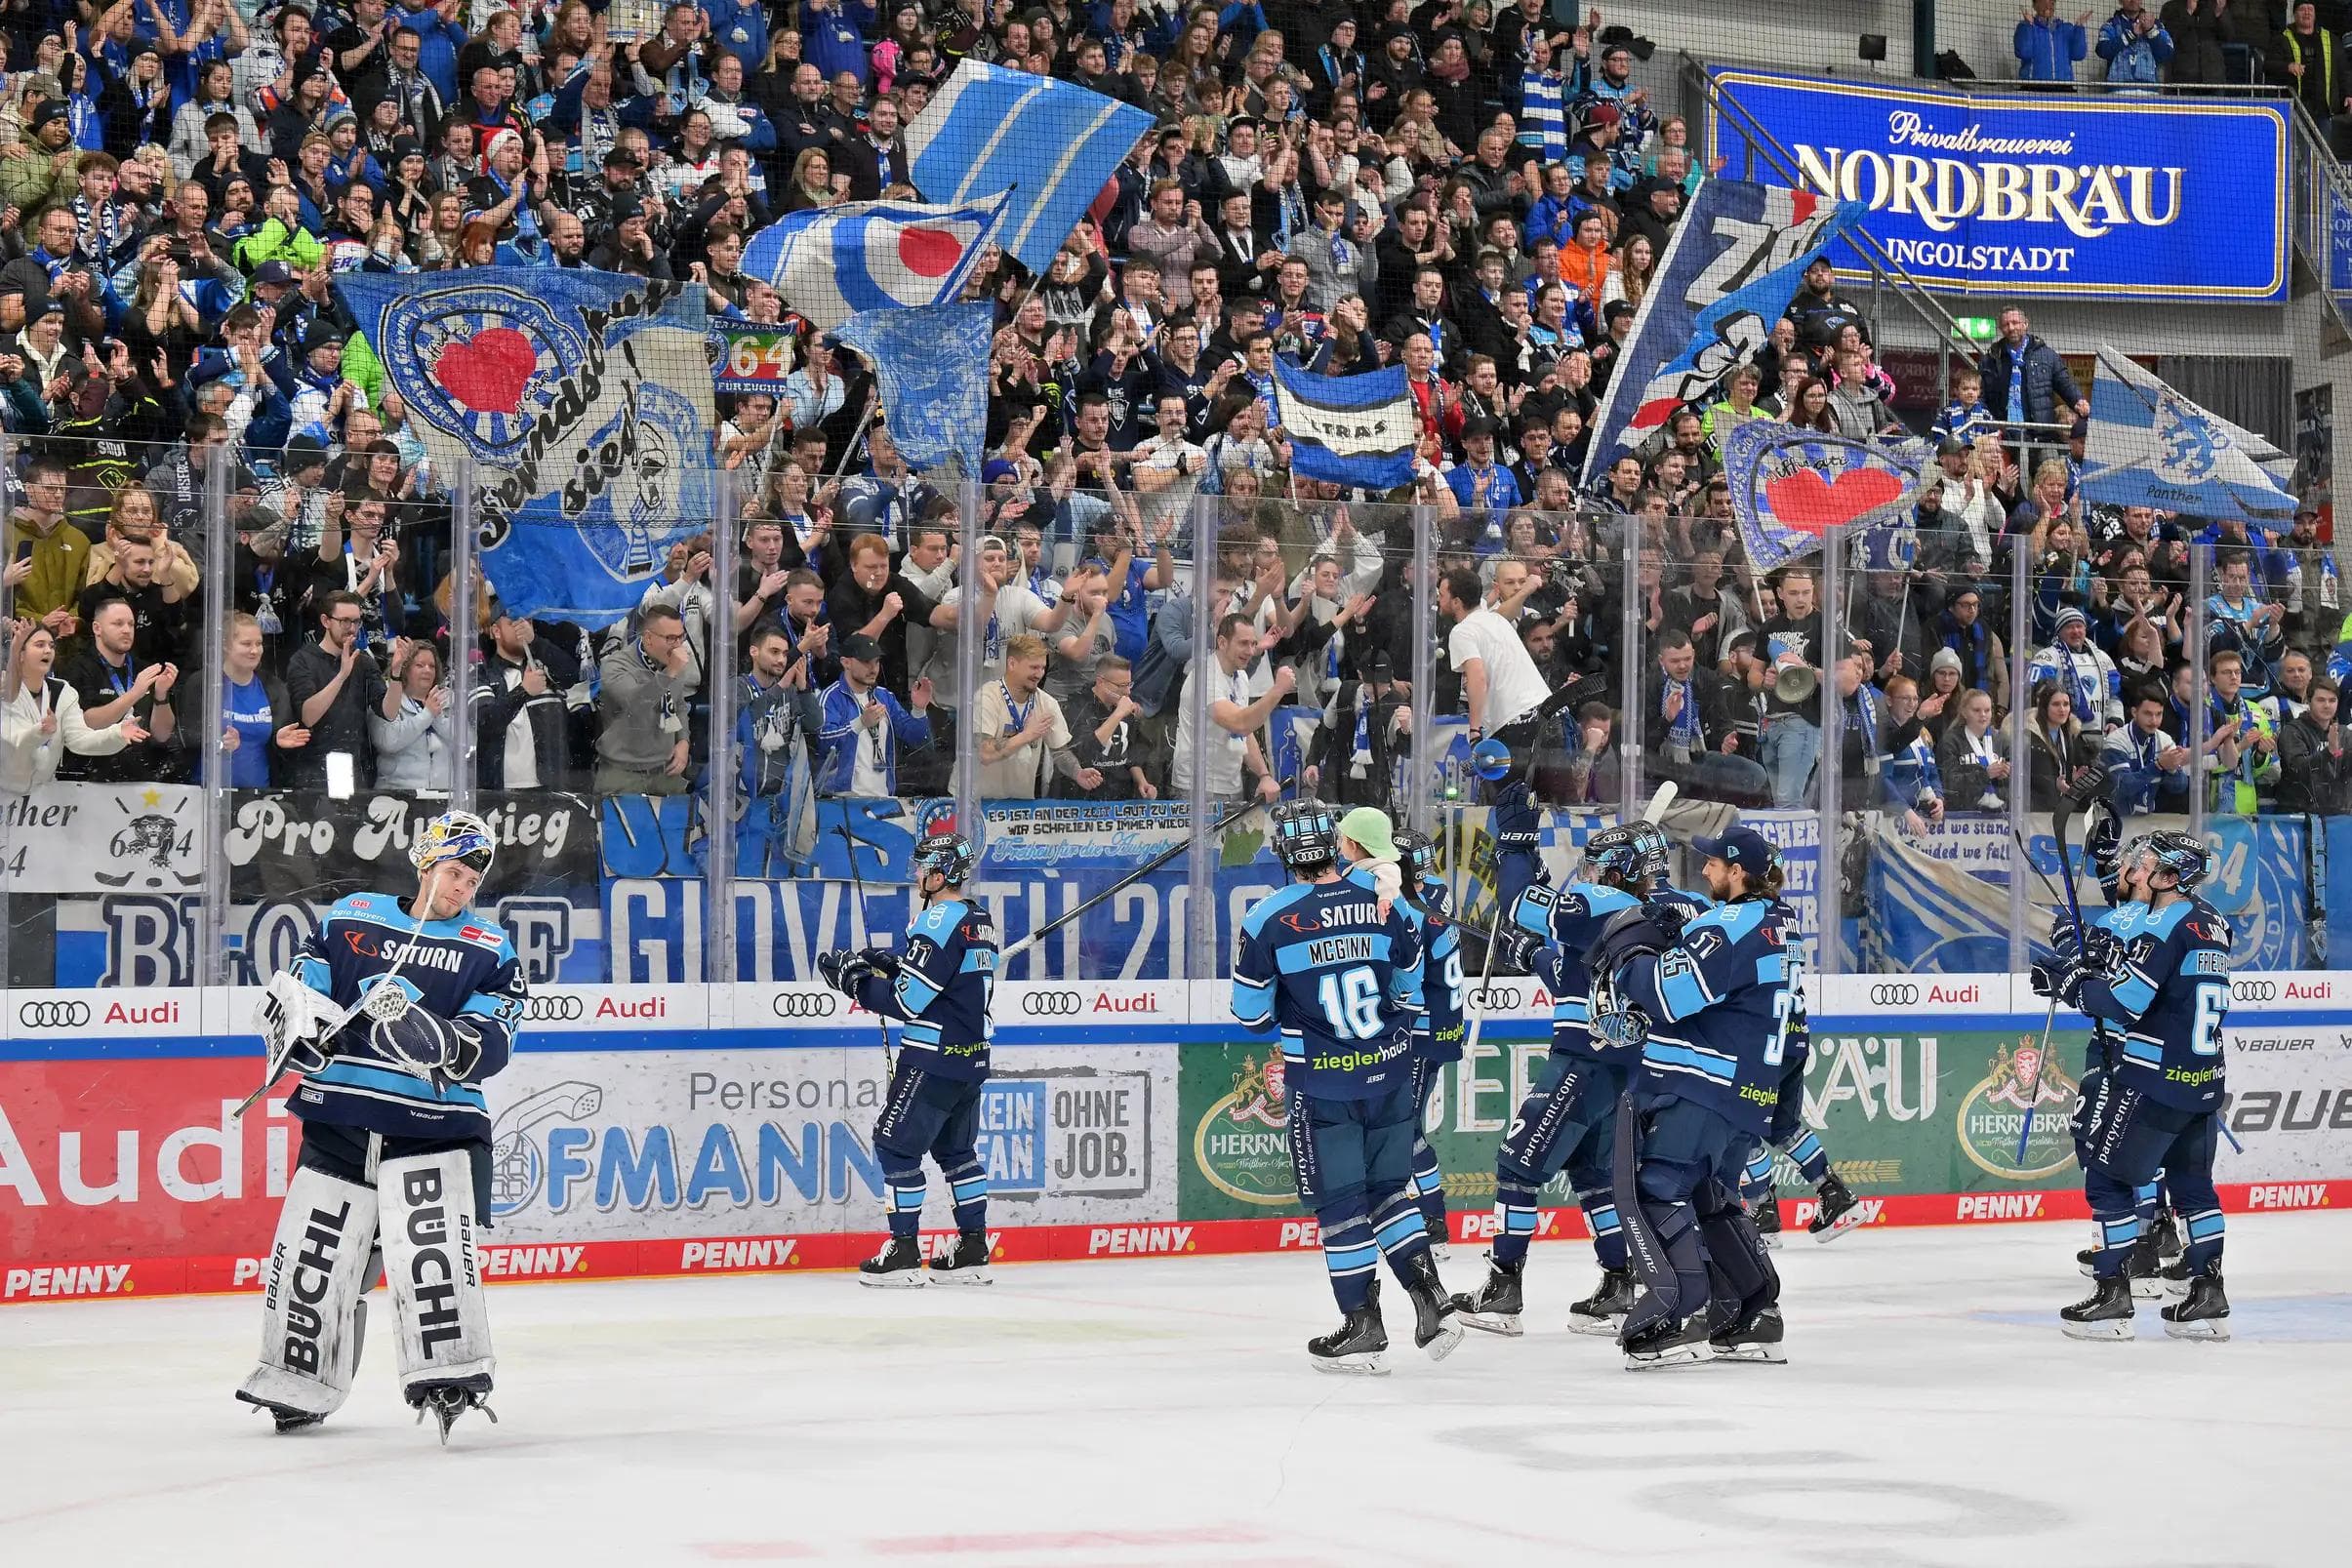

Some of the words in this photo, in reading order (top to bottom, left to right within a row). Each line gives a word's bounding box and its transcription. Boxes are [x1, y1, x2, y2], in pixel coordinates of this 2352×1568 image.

[1887, 110, 2075, 154] Privatbrauerei
[1793, 143, 2184, 237] NORDBRÄU
[1886, 237, 2075, 272] INGOLSTADT
[2146, 484, 2202, 504] Panther
[223, 794, 335, 866] Pro
[988, 811, 1006, 823] ES
[1009, 809, 1031, 822] IST
[1034, 809, 1051, 821] AN
[1055, 807, 1079, 820] DER
[1115, 805, 1147, 817] LAUT
[1151, 804, 1167, 816] ZU
[1033, 822, 1094, 835] SCHREIEN
[1096, 821, 1114, 832] ES
[1115, 819, 1155, 831] IMMER
[1951, 824, 1970, 835] we
[1963, 847, 1982, 860] we
[381, 940, 465, 974] SATURN
[1309, 936, 1371, 965] MCGINN
[595, 996, 667, 1018] Audi
[1093, 992, 1156, 1013] Audi
[1318, 965, 1385, 1040] 16
[1928, 985, 1979, 1003] Audi
[2285, 982, 2332, 999] Audi
[104, 1002, 180, 1024] Audi
[1313, 1039, 1408, 1072] zieglerhaus
[1054, 1090, 1129, 1128] OHNE
[1520, 1071, 1578, 1168] partyrent.com
[1054, 1132, 1137, 1180] JOB.
[403, 1168, 463, 1359] BÜCHL
[284, 1201, 351, 1375] BÜCHL
